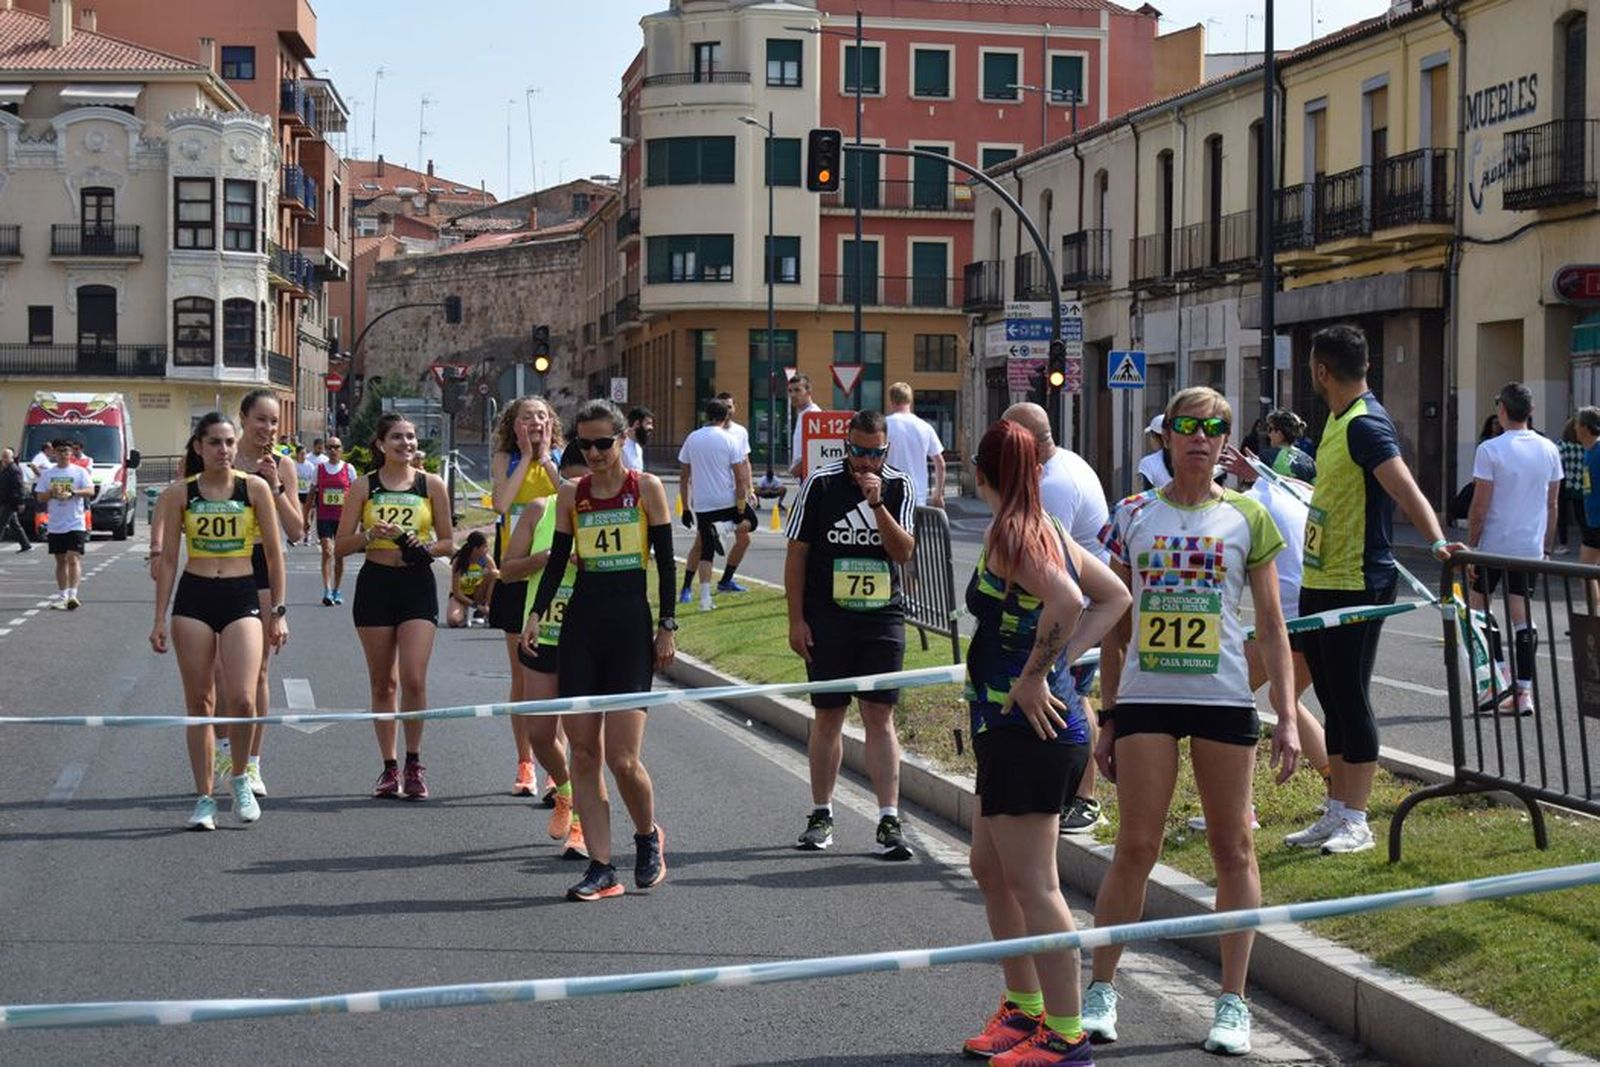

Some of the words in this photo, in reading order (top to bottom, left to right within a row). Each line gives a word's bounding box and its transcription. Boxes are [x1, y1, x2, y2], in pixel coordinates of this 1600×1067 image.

[1466, 73, 1538, 131] MUEBLES
[820, 445, 843, 458] km
[327, 495, 339, 503] 89
[376, 506, 414, 526] 122
[197, 516, 237, 537] 201
[827, 527, 882, 546] adida
[595, 527, 621, 552] 41
[847, 575, 876, 596] 75
[1148, 617, 1207, 648] 212
[1182, 658, 1214, 668] RURAL
